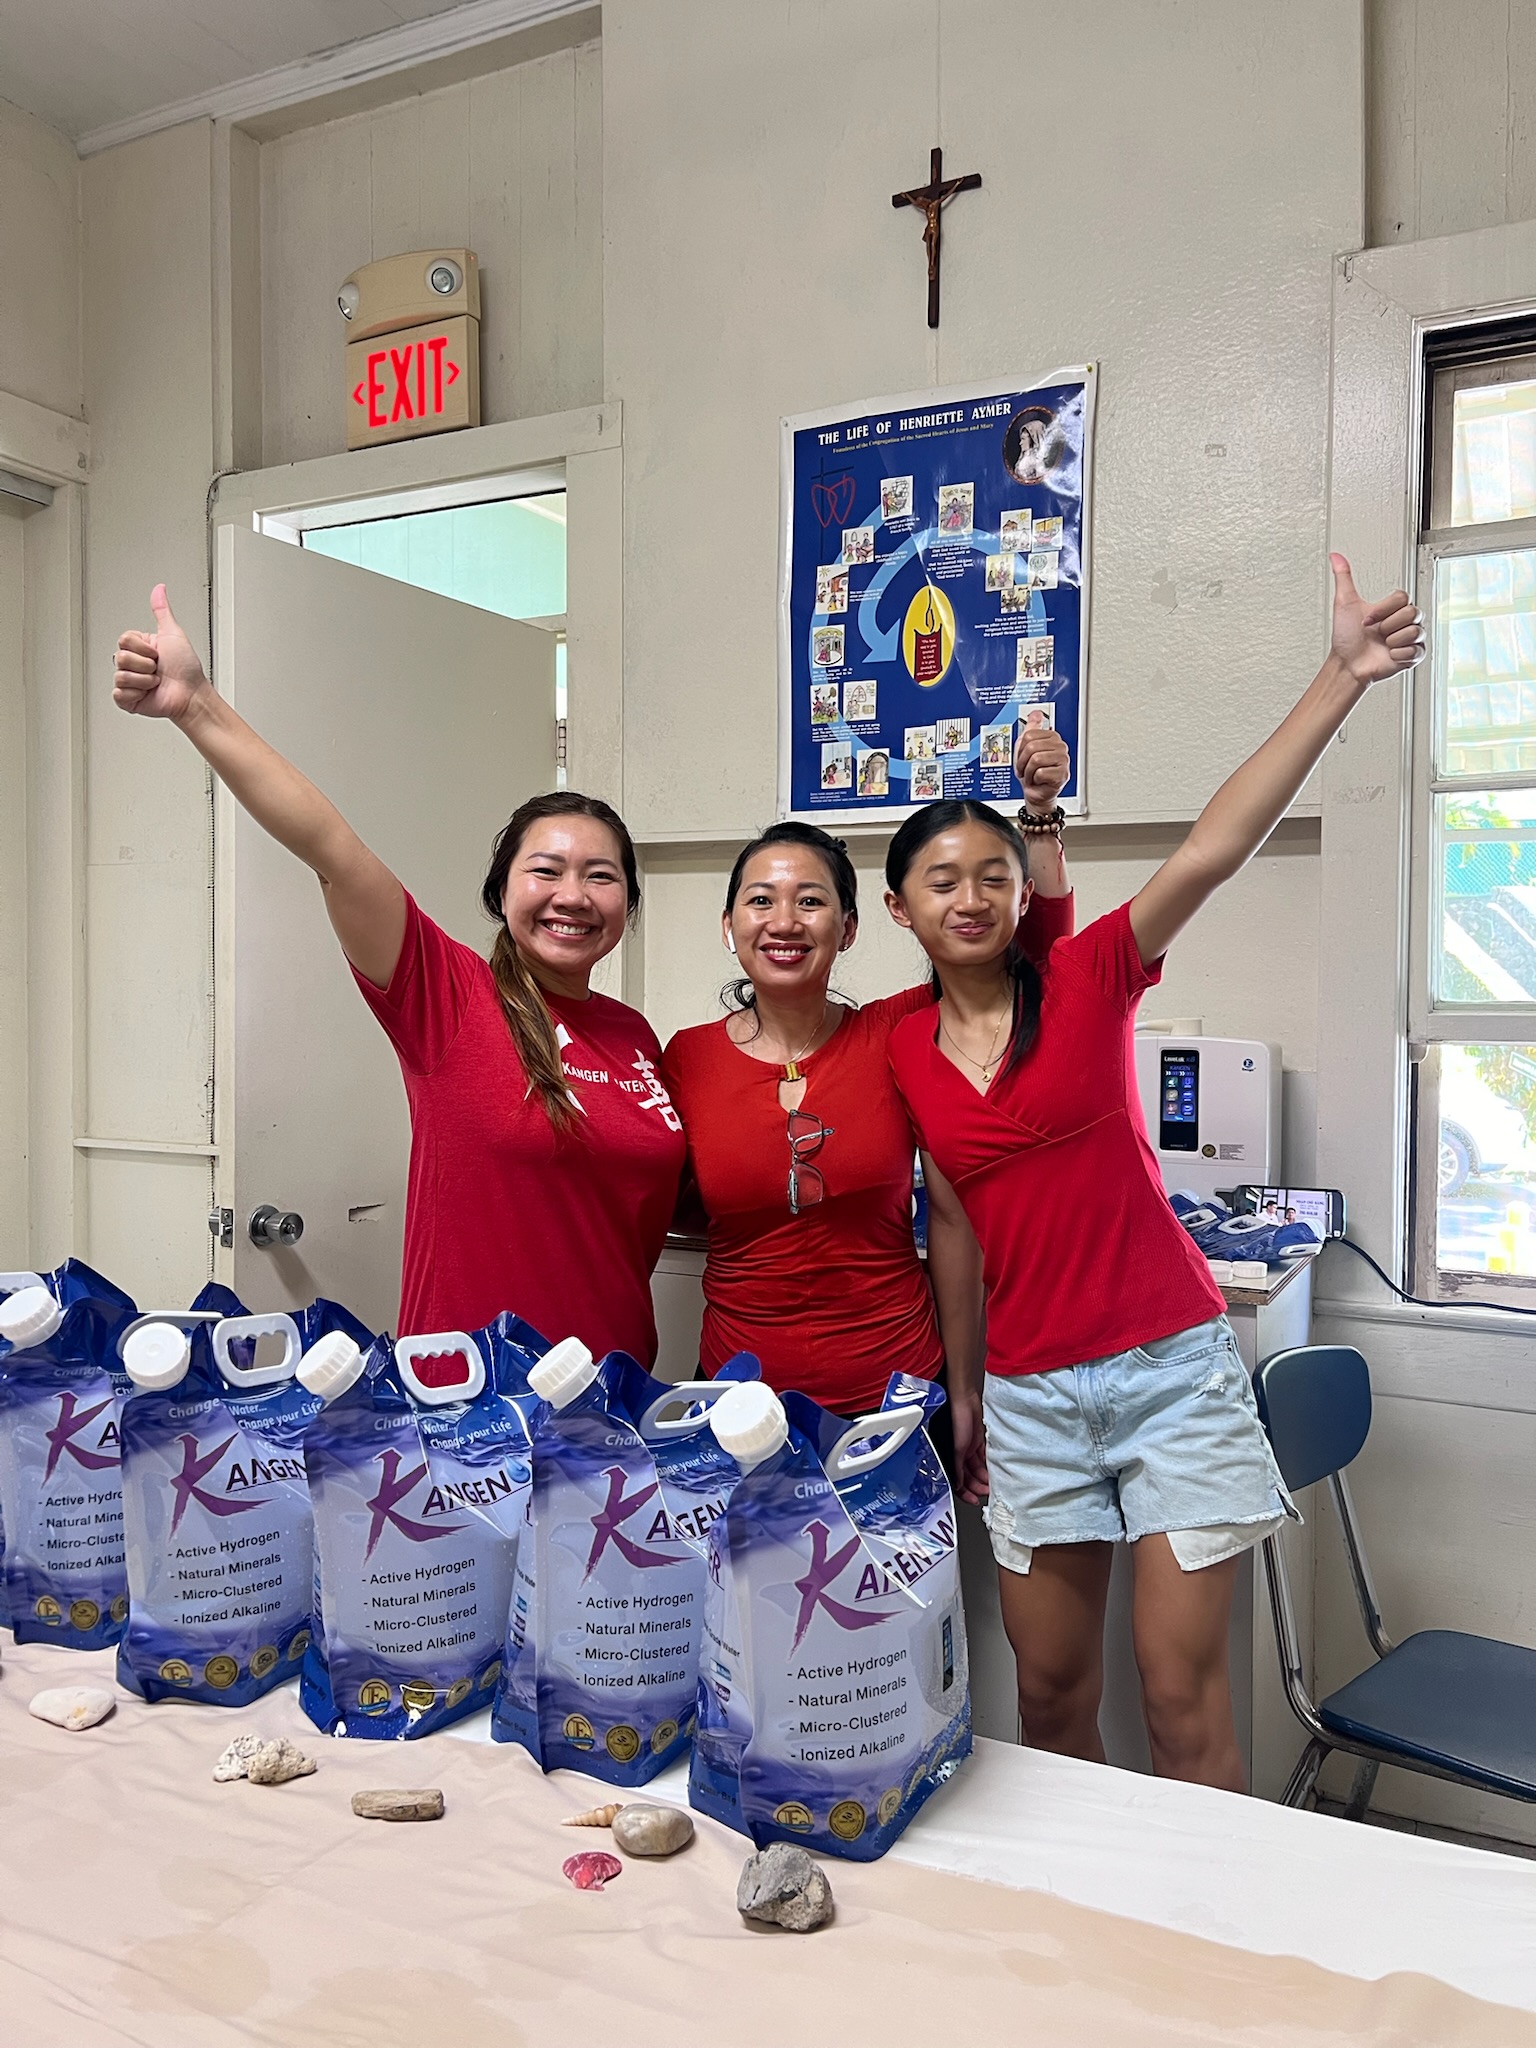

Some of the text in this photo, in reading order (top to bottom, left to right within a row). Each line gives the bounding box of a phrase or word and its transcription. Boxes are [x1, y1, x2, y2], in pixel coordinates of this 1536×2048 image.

[368, 337, 447, 428] EXIT
[818, 402, 1011, 446] THE LIFE OF HENRIETTE AYMER
[562, 1062, 647, 1093] KANGEN ATER
[168, 1397, 220, 1419] Change
[237, 1416, 275, 1431] Change
[276, 1411, 299, 1427] your
[430, 1421, 513, 1450] Change your Life
[679, 1458, 701, 1472] your
[700, 1451, 721, 1463] Life
[45, 1495, 85, 1507] Active
[862, 1495, 882, 1515] your
[876, 1490, 897, 1503] Life
[46, 1516, 91, 1528] Natural
[176, 1530, 281, 1559] Active Hydrogen
[48, 1558, 91, 1571] Ionized
[178, 1553, 282, 1581] Natural Minerals
[369, 1558, 476, 1585] Active Hydrogen
[182, 1575, 283, 1600] Micro-Clustered
[372, 1581, 476, 1608] Natural Minerals
[182, 1601, 281, 1624] Ionized Alkaline
[585, 1592, 694, 1611] Active Hydrogen
[374, 1604, 477, 1631] Micro-Clustered
[585, 1622, 635, 1635] Natural
[639, 1617, 692, 1633] Minerals
[376, 1630, 476, 1653] Ionized Alkaline
[585, 1642, 690, 1661] Micro-Clustered
[797, 1649, 908, 1680] Active Hydrogen
[584, 1669, 686, 1687] Ionized Alkaline
[798, 1675, 907, 1707] Natural Minerals
[799, 1701, 908, 1734] Micro-Clustered
[800, 1732, 906, 1761] Ionized Alkaline
